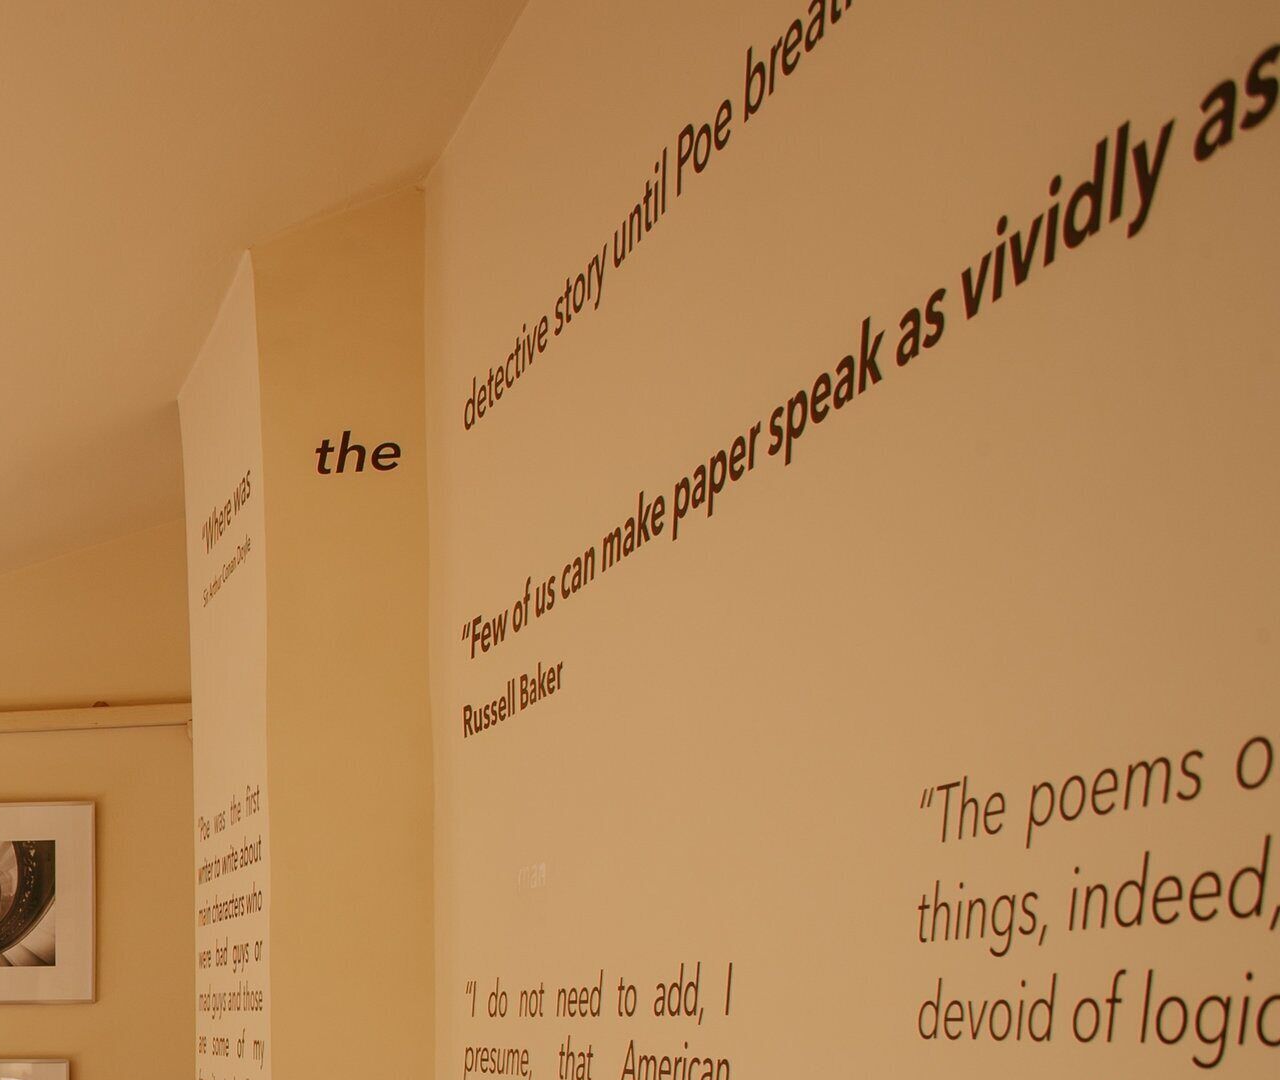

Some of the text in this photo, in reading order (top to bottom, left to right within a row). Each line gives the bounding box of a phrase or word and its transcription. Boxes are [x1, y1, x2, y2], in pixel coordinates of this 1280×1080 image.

[464, 0, 852, 430] detective story until Poe brea
[462, 44, 1280, 659] "Few of us can make paper speak as vividly as
[314, 430, 401, 476] the
[201, 469, 251, 555] "Where was
[221, 556, 237, 584] Conan
[463, 661, 563, 738] Russell Baker
[197, 784, 261, 842] "Poe was the first
[920, 776, 1005, 843] "The
[1026, 750, 1204, 849] poems
[198, 856, 214, 886] writer
[221, 844, 239, 876] write
[240, 834, 262, 868] about
[918, 834, 1280, 957] things, indeed,
[466, 961, 732, 1025] "I do not need to add, I
[918, 973, 1057, 1042] devoid
[1073, 969, 1127, 1043] of
